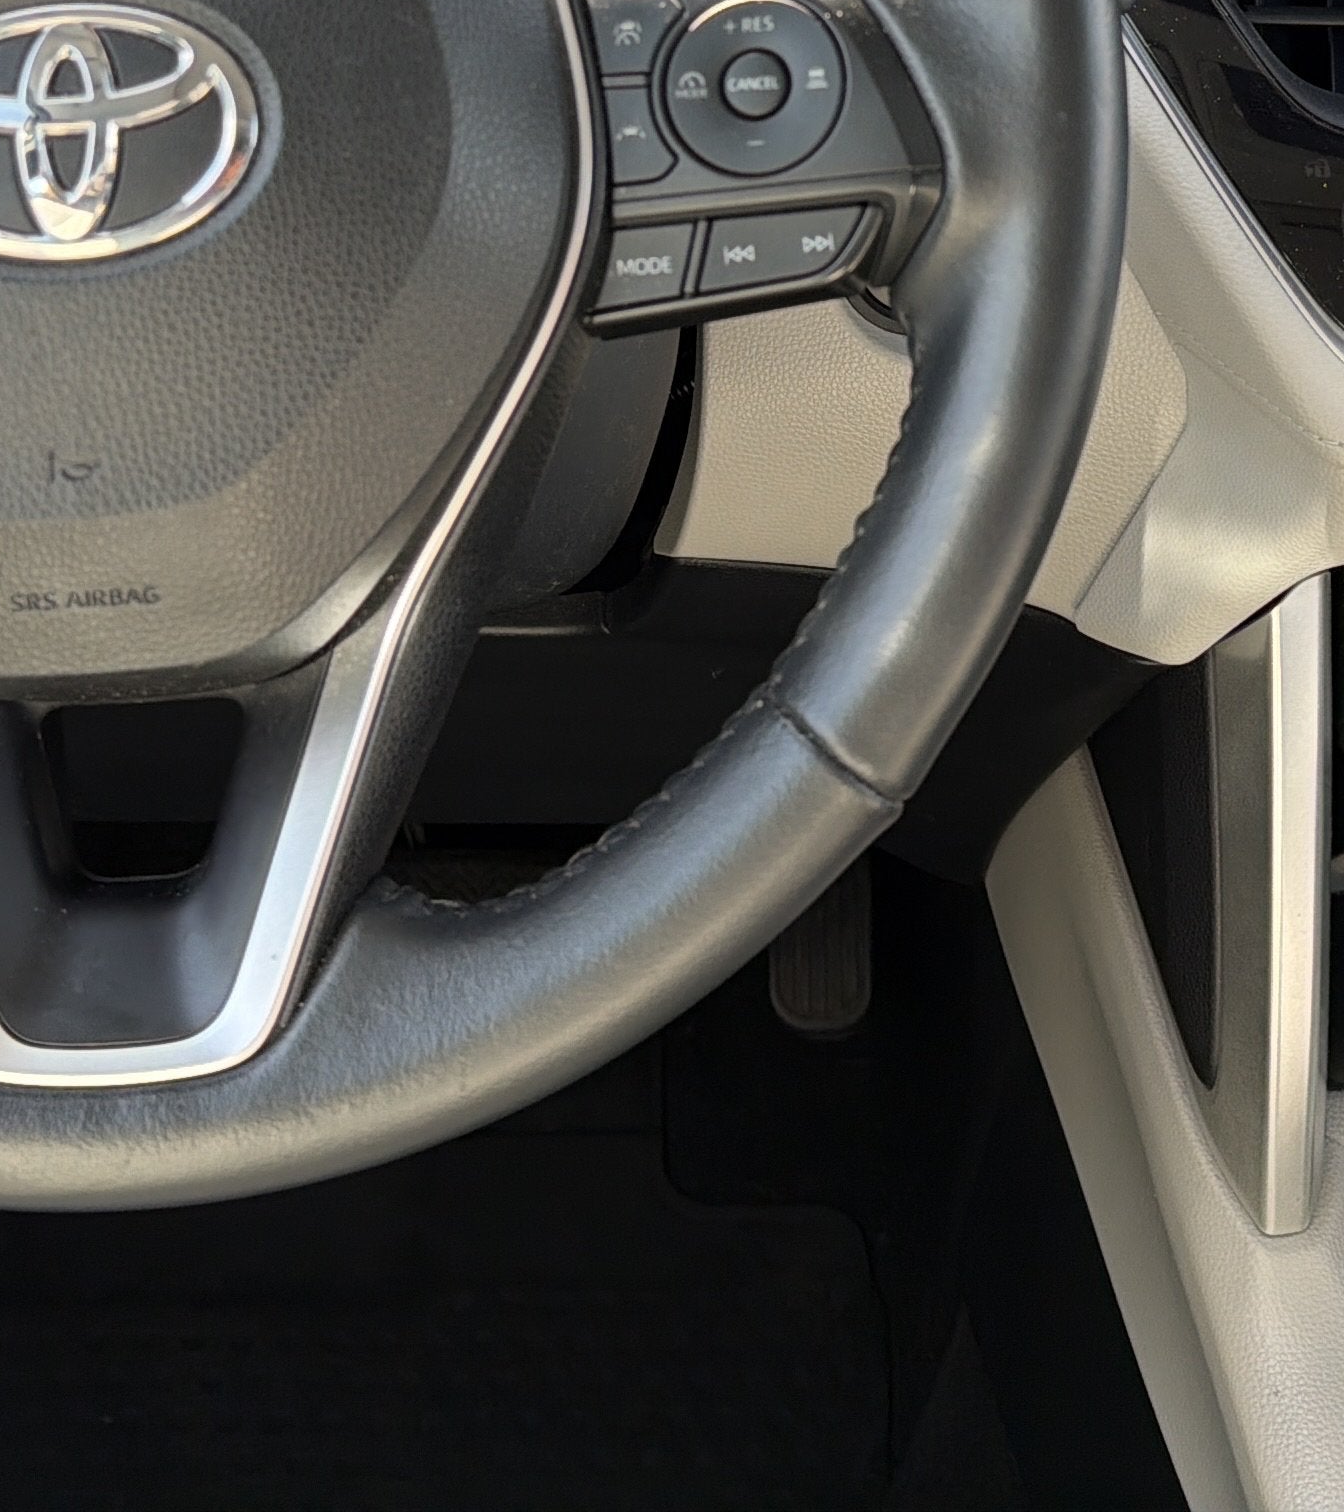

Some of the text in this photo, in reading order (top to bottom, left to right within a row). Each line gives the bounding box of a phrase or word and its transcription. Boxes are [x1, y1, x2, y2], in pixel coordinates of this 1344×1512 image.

[741, 16, 775, 33] RES
[728, 75, 779, 92] CANCEL
[616, 256, 673, 277] MODE
[11, 586, 161, 612] SRS AIRBAG
